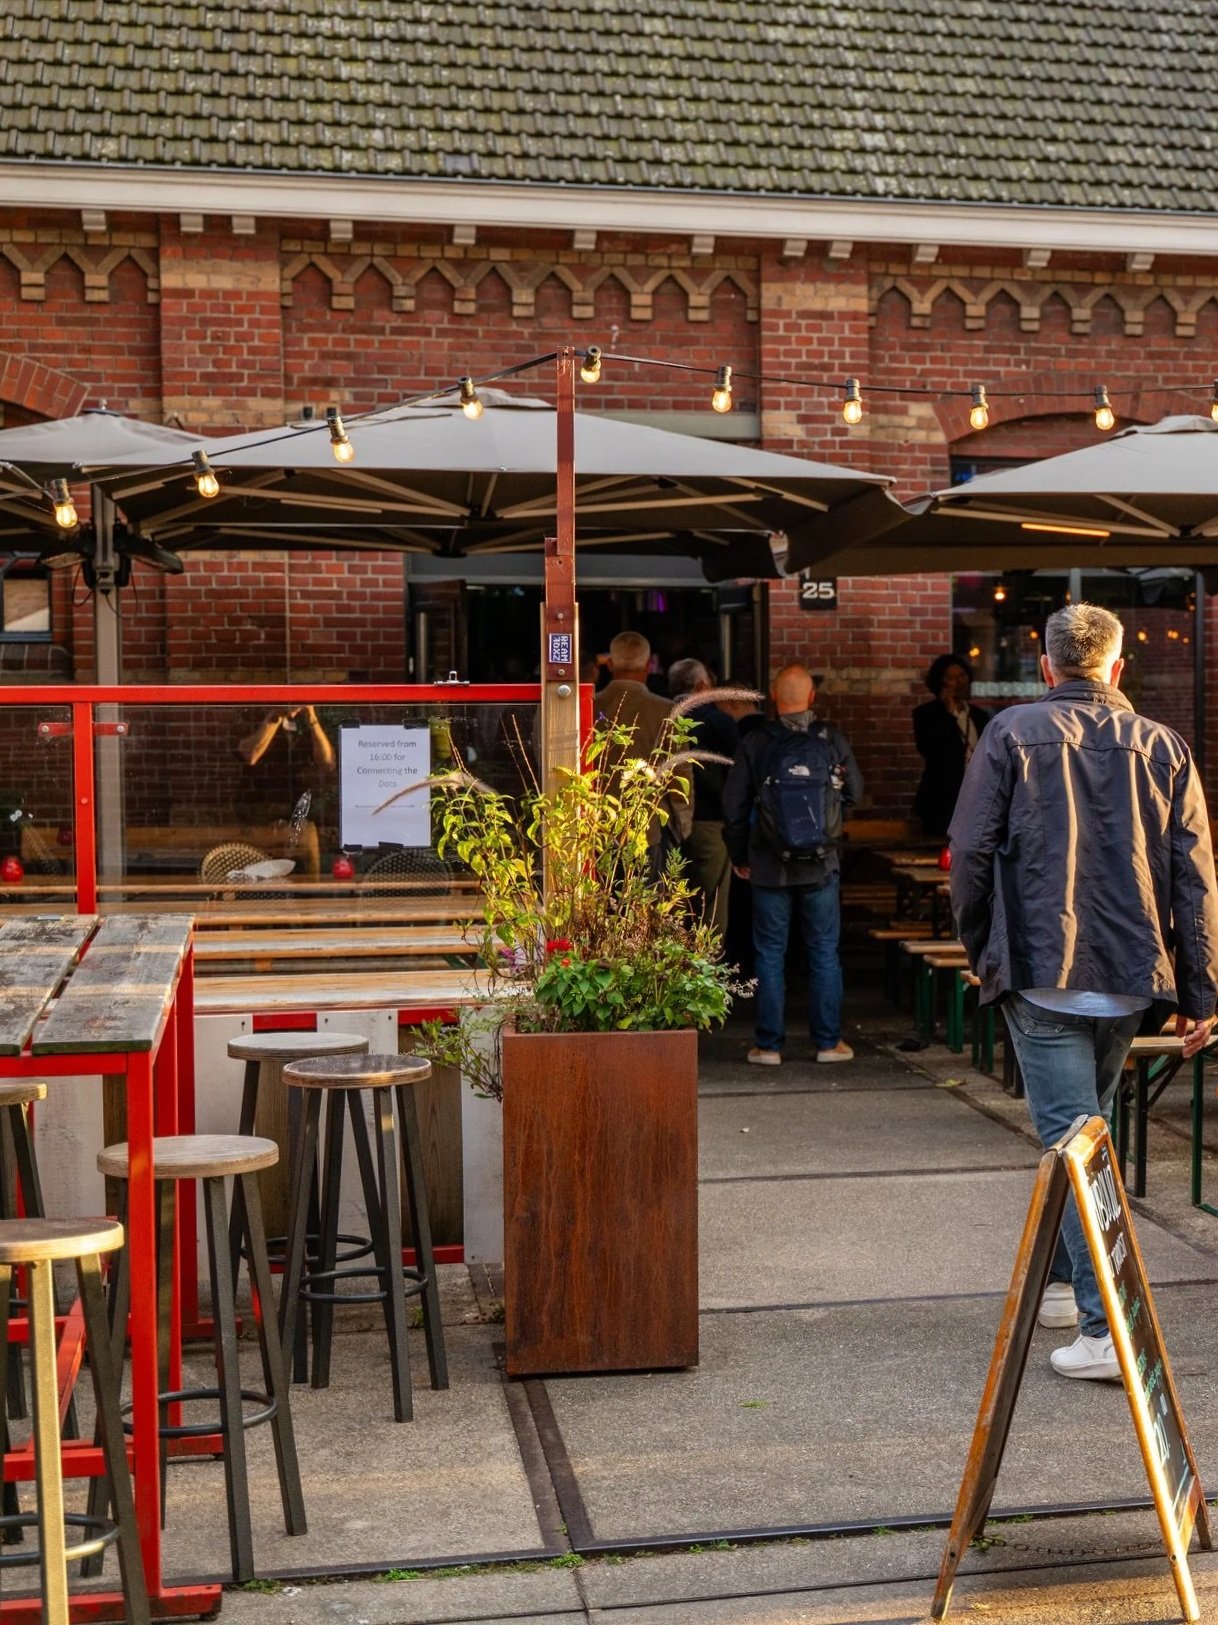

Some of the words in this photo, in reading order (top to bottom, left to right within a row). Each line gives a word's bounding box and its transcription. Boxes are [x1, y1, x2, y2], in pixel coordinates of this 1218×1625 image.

[802, 582, 835, 600] 25
[358, 740, 395, 748] Reserved
[397, 740, 417, 748] from
[370, 753, 392, 761] 16:00
[394, 753, 405, 761] for
[357, 766, 403, 775] Connecting
[405, 767, 418, 775] the
[378, 780, 397, 788] Dots
